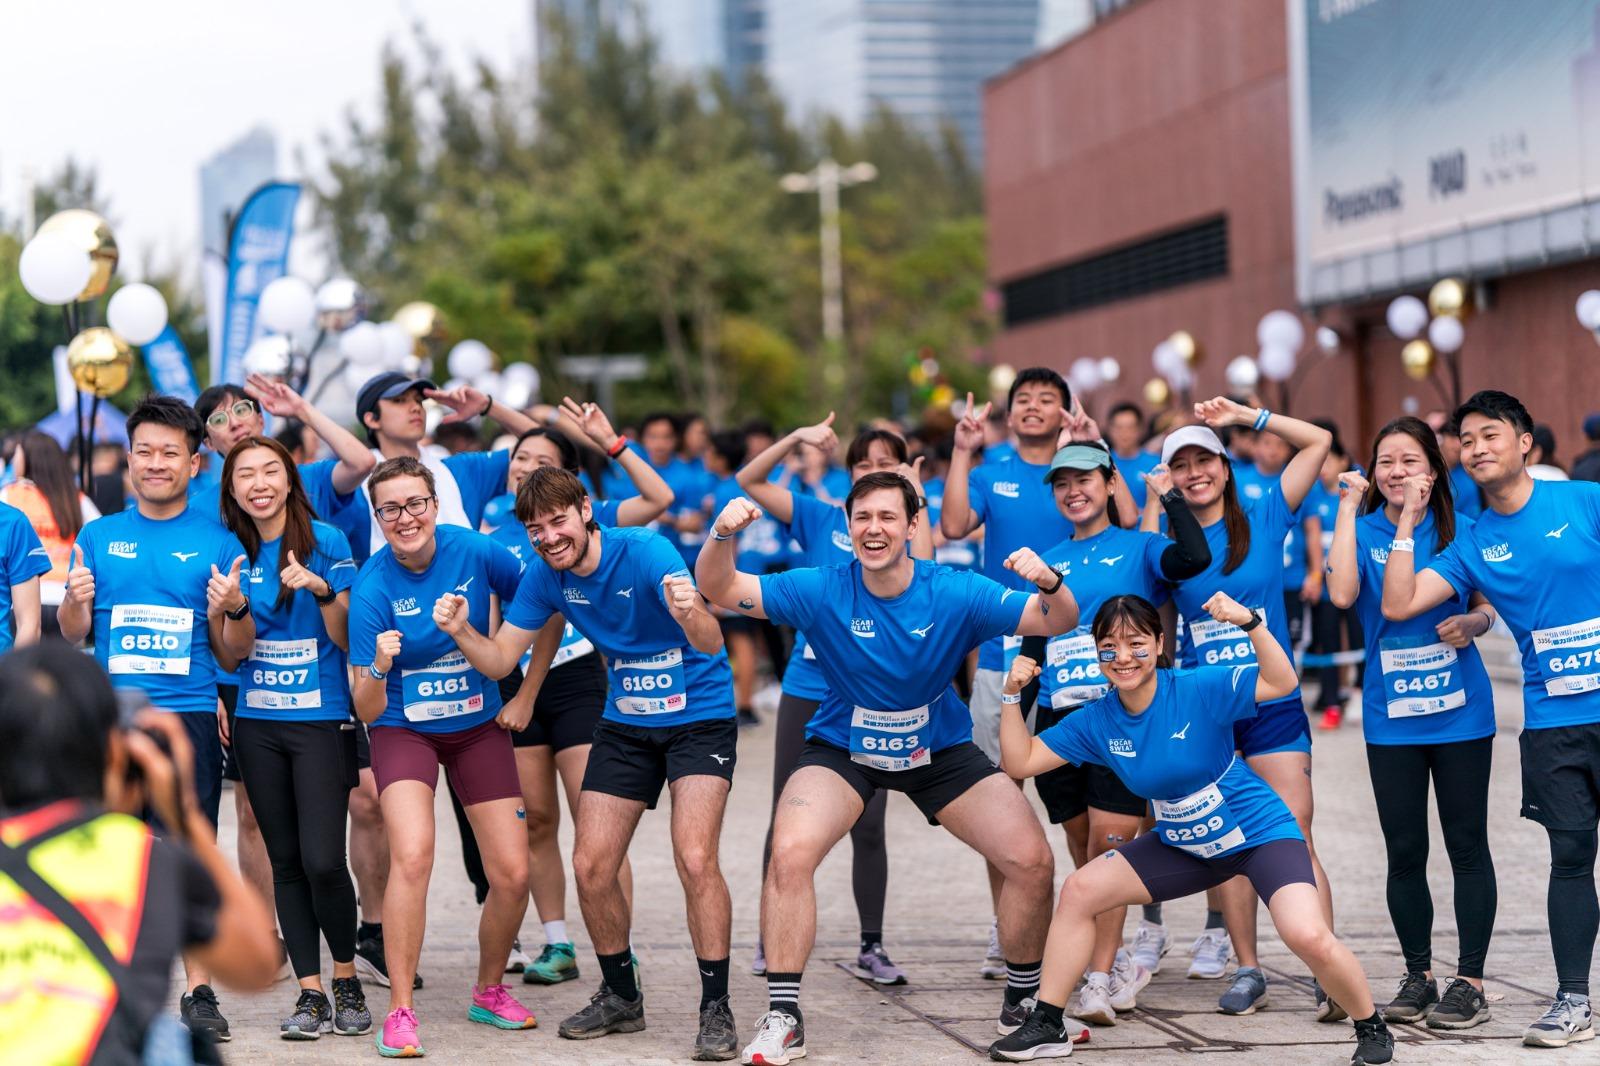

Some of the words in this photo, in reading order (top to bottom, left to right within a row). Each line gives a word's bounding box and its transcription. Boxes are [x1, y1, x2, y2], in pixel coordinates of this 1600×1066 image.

[121, 634, 179, 650] 6510
[253, 669, 308, 686] 6507
[418, 676, 469, 697] 6161
[622, 673, 672, 691] 6160
[1394, 671, 1451, 694] 6467
[862, 735, 919, 751] 6163
[1166, 816, 1223, 841] 6299
